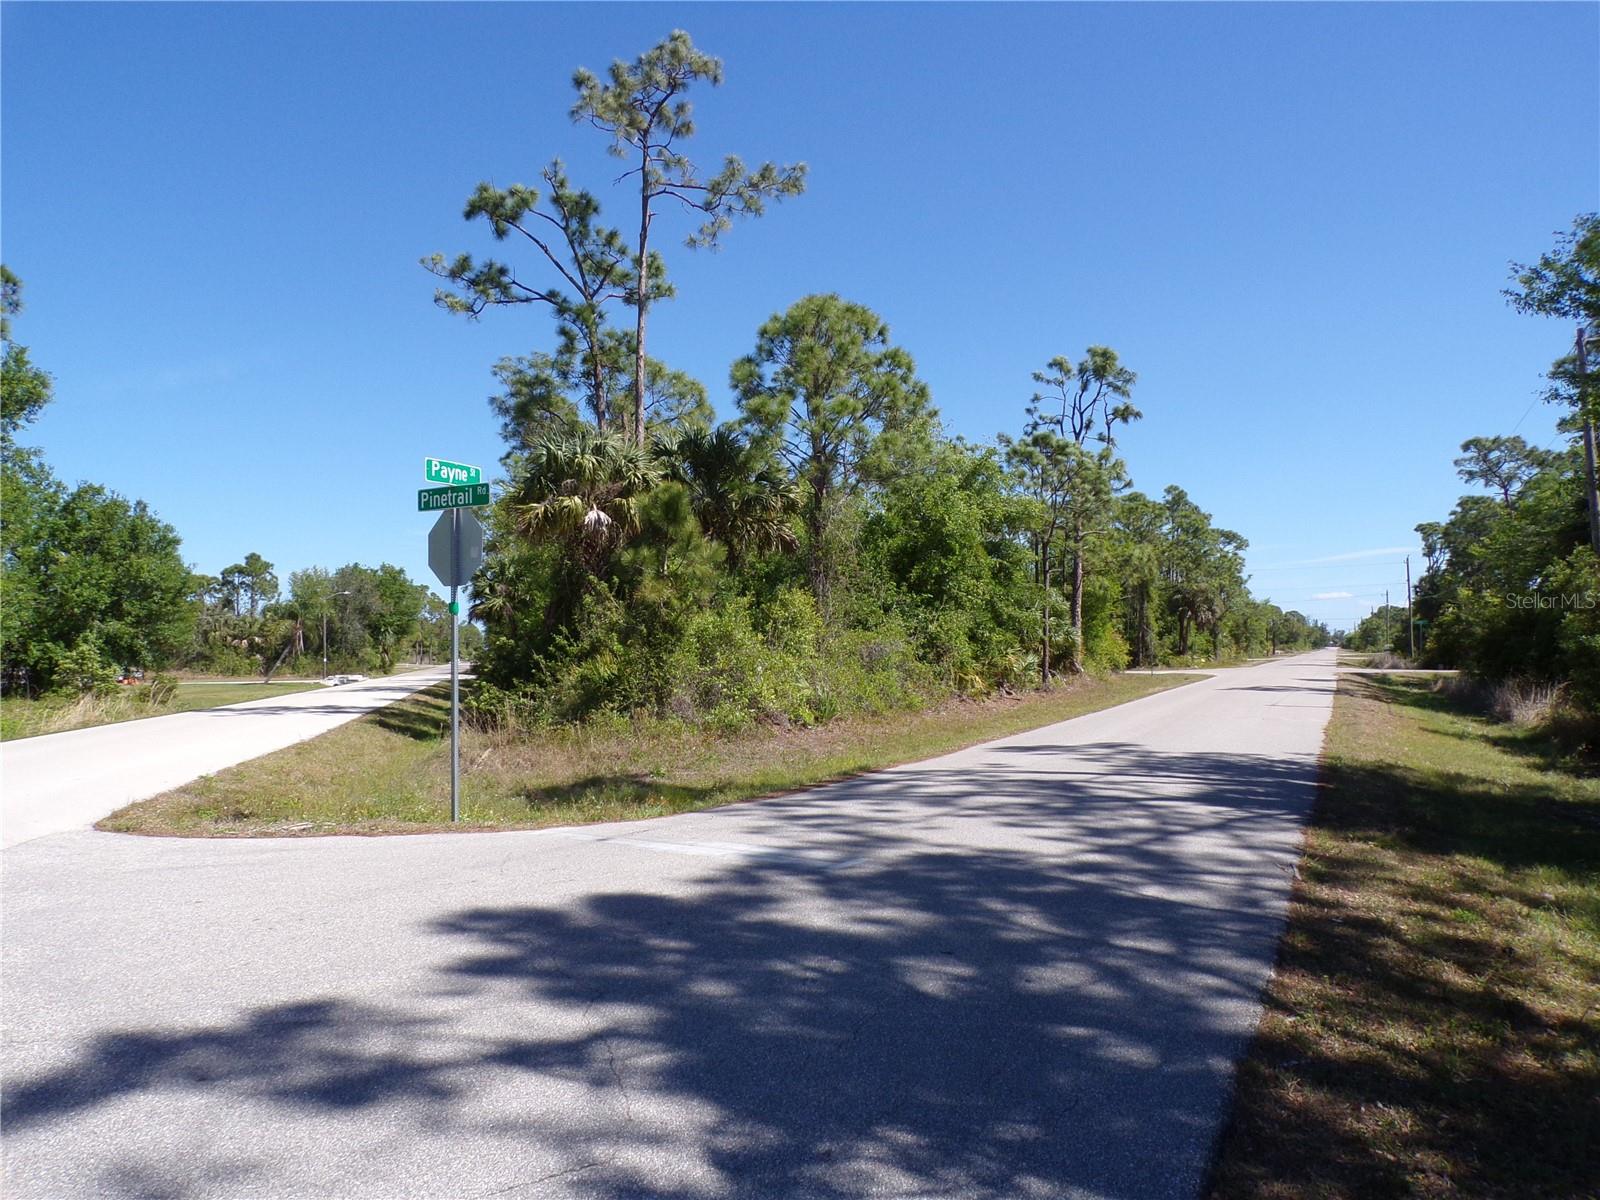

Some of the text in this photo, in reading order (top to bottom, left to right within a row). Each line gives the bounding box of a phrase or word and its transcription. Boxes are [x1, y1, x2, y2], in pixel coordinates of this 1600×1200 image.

[431, 460, 468, 484] Payne
[421, 486, 487, 509] Pinetrail Rd
